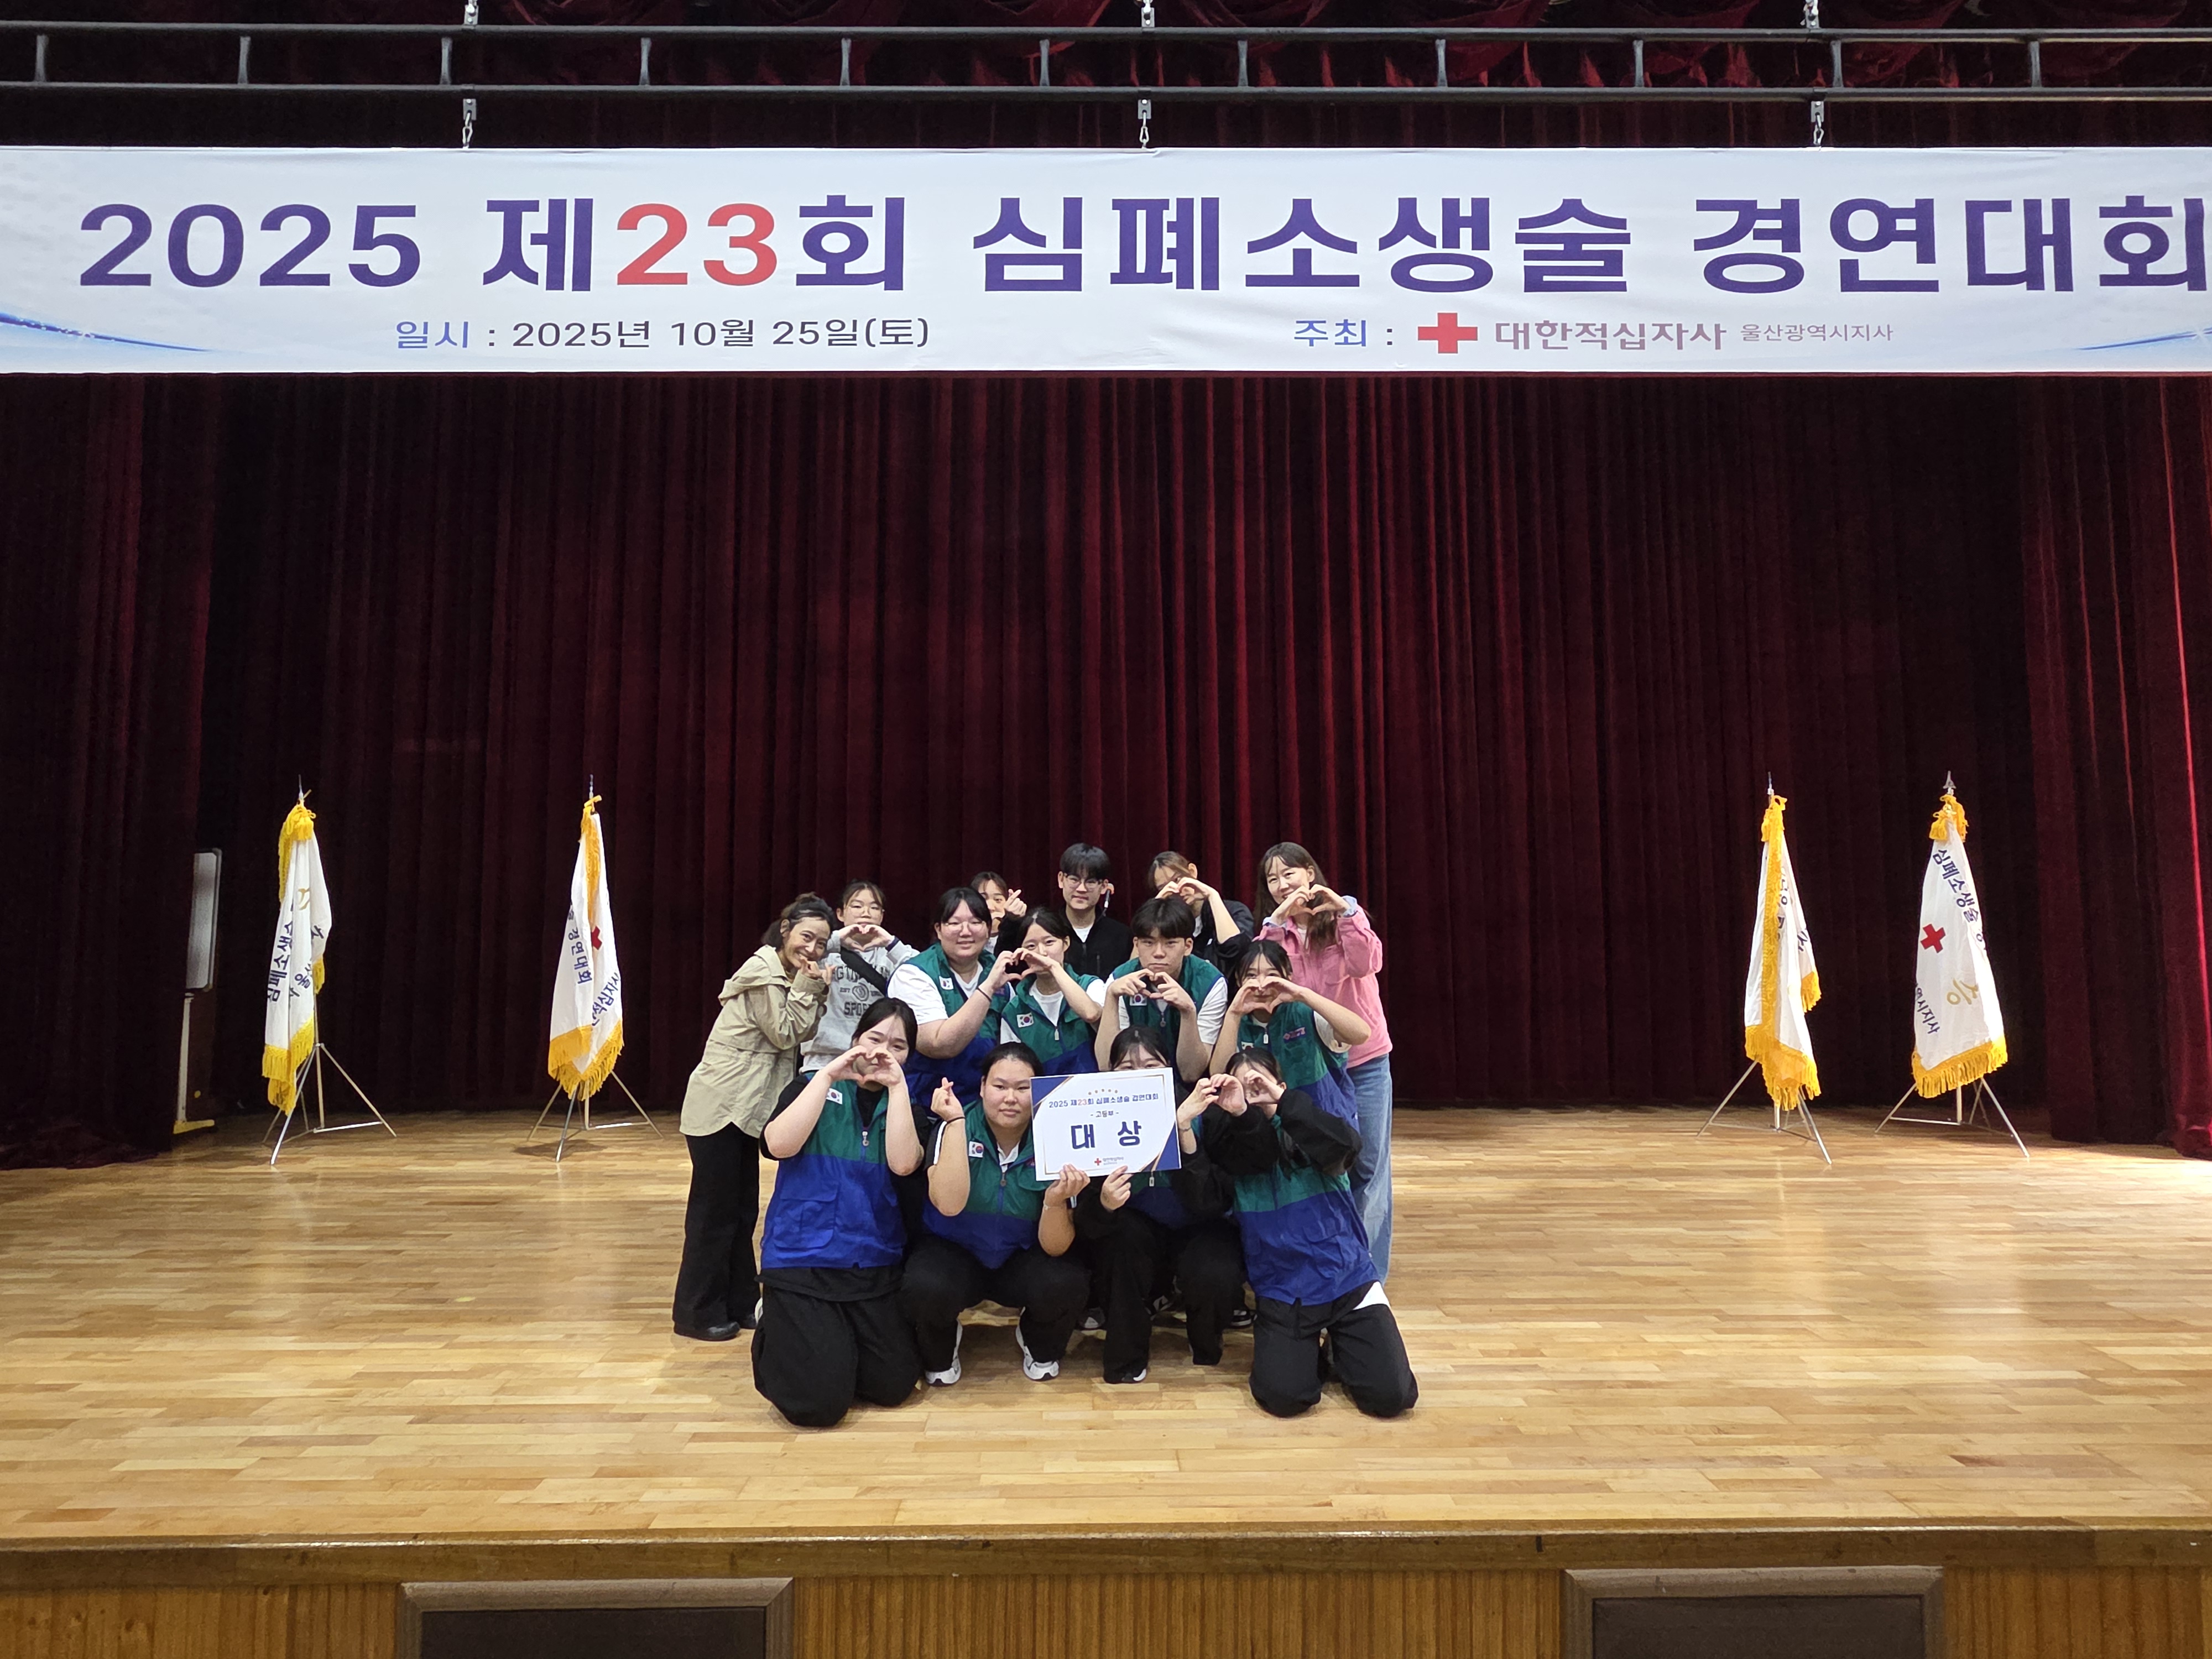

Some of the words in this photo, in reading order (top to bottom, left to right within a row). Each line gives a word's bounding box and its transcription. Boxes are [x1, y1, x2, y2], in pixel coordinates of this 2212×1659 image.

[80, 204, 420, 288] 2025
[482, 195, 905, 292] 제23회
[973, 197, 1631, 293] 심폐소생술
[1693, 195, 2207, 294] 경연대회
[396, 321, 469, 349] 일시
[513, 321, 650, 348] 2025년
[671, 319, 754, 347] 10월
[773, 318, 928, 348] 25일(토)
[1294, 319, 1366, 347] 주최
[1495, 320, 1727, 351] 대한적십자사
[1740, 324, 1894, 342] 울산광역시지사
[1932, 849, 1979, 923] 심폐소생술
[568, 927, 593, 984] 경연대회
[1048, 1100, 1068, 1108] 2025
[1071, 1098, 1094, 1106] 제23회
